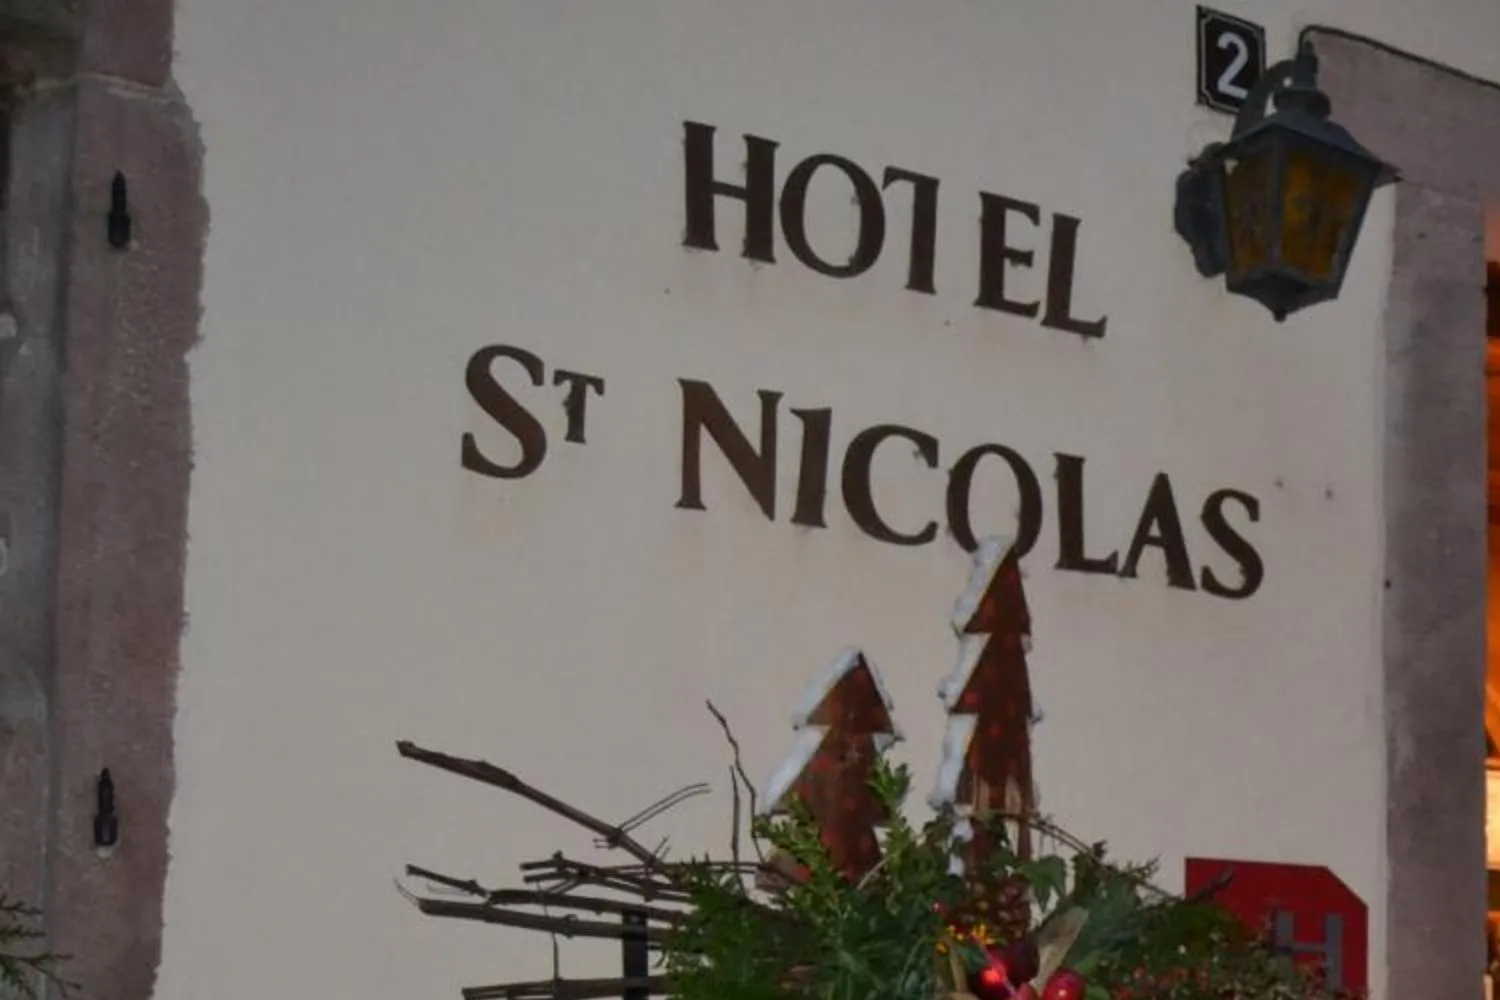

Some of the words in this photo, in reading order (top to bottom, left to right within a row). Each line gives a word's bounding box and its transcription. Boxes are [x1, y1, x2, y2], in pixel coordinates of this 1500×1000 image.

[1217, 31, 1248, 99] 2
[682, 120, 1108, 339] HOTEL
[675, 377, 1264, 600] NICOLAS
